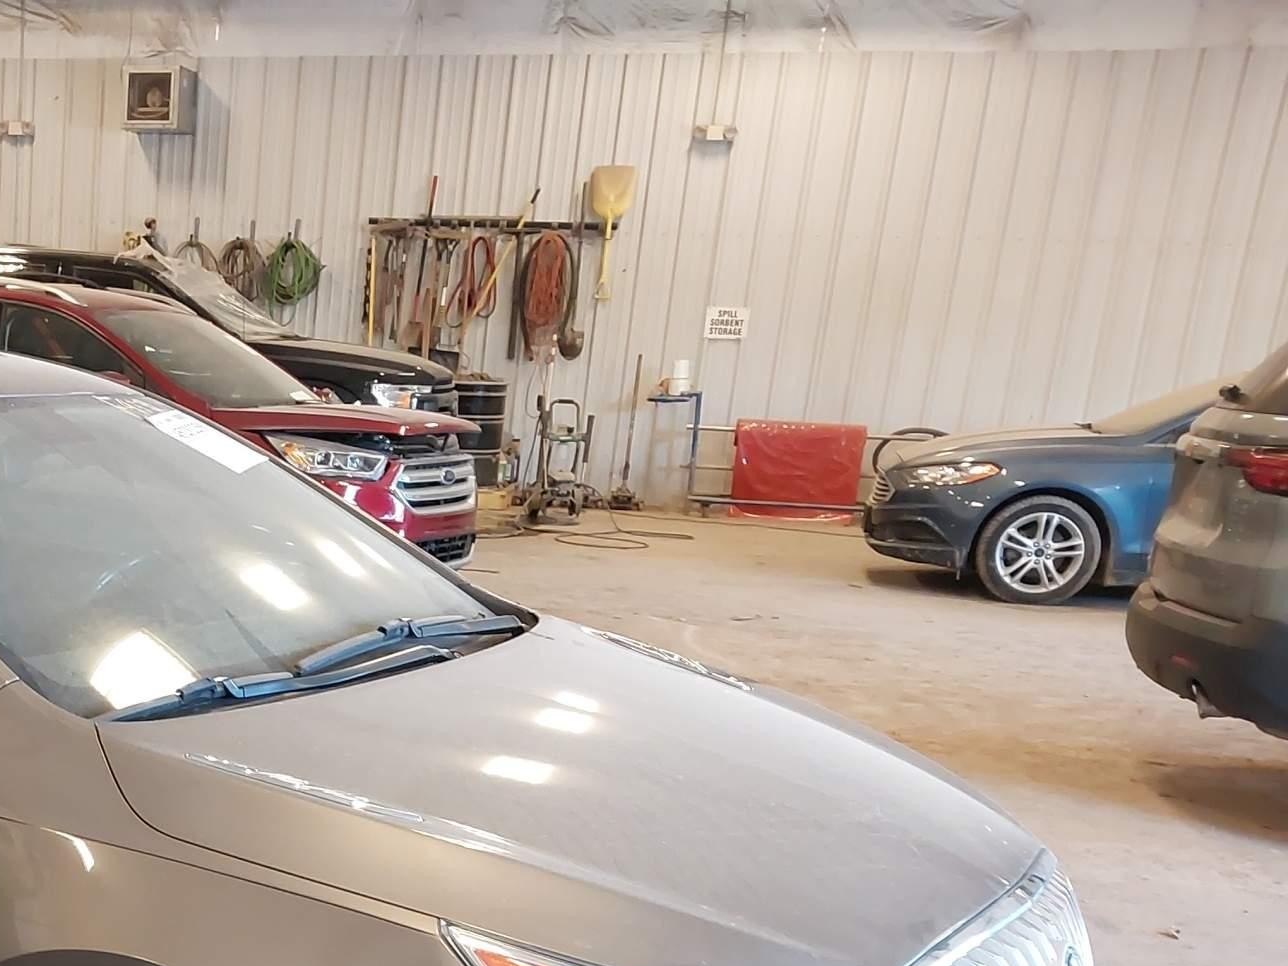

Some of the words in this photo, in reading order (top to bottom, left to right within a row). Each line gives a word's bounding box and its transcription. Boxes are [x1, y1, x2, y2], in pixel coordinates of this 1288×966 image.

[718, 310, 738, 318] SPILL
[710, 318, 744, 327] SORBENT
[709, 327, 743, 336] STORAGE
